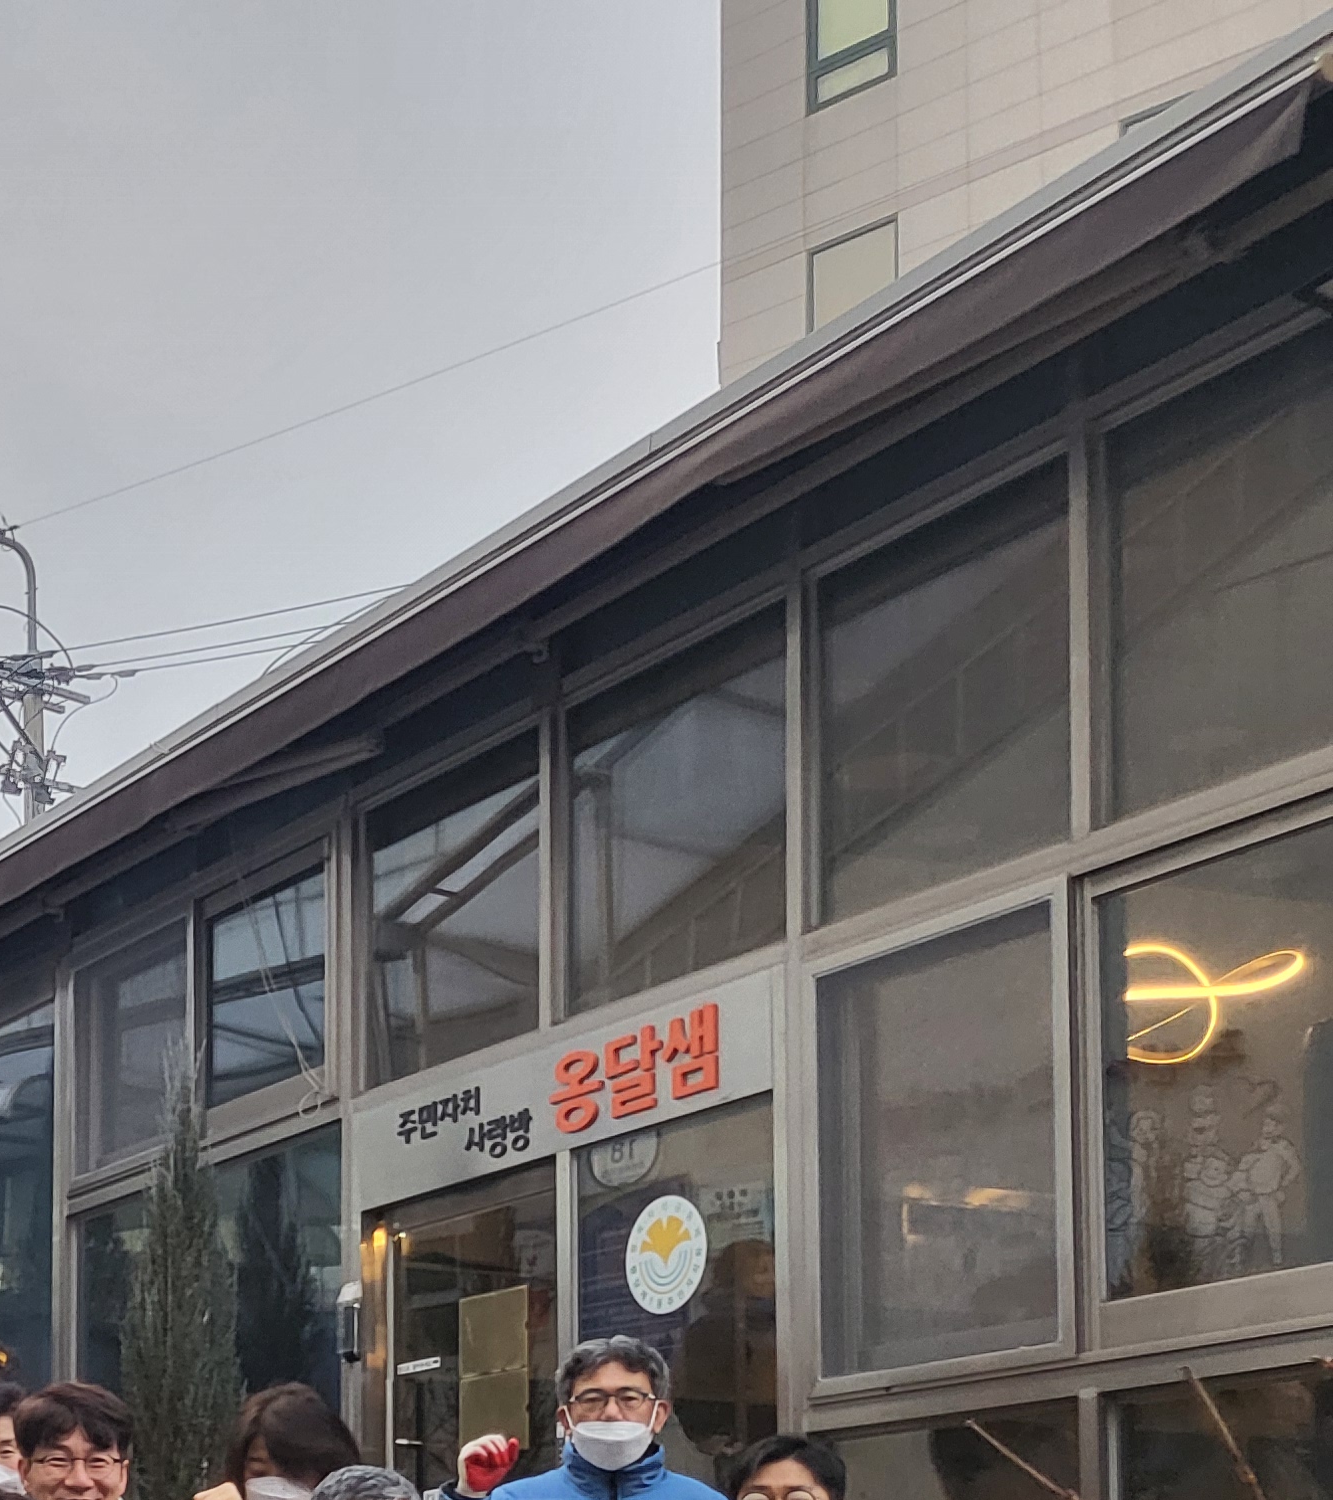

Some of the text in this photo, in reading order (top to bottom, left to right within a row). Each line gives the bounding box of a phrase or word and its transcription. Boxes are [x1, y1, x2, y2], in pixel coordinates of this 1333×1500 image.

[396, 1002, 720, 1145] 주민자치 옹달샘
[463, 1108, 533, 1159] 사랑방
